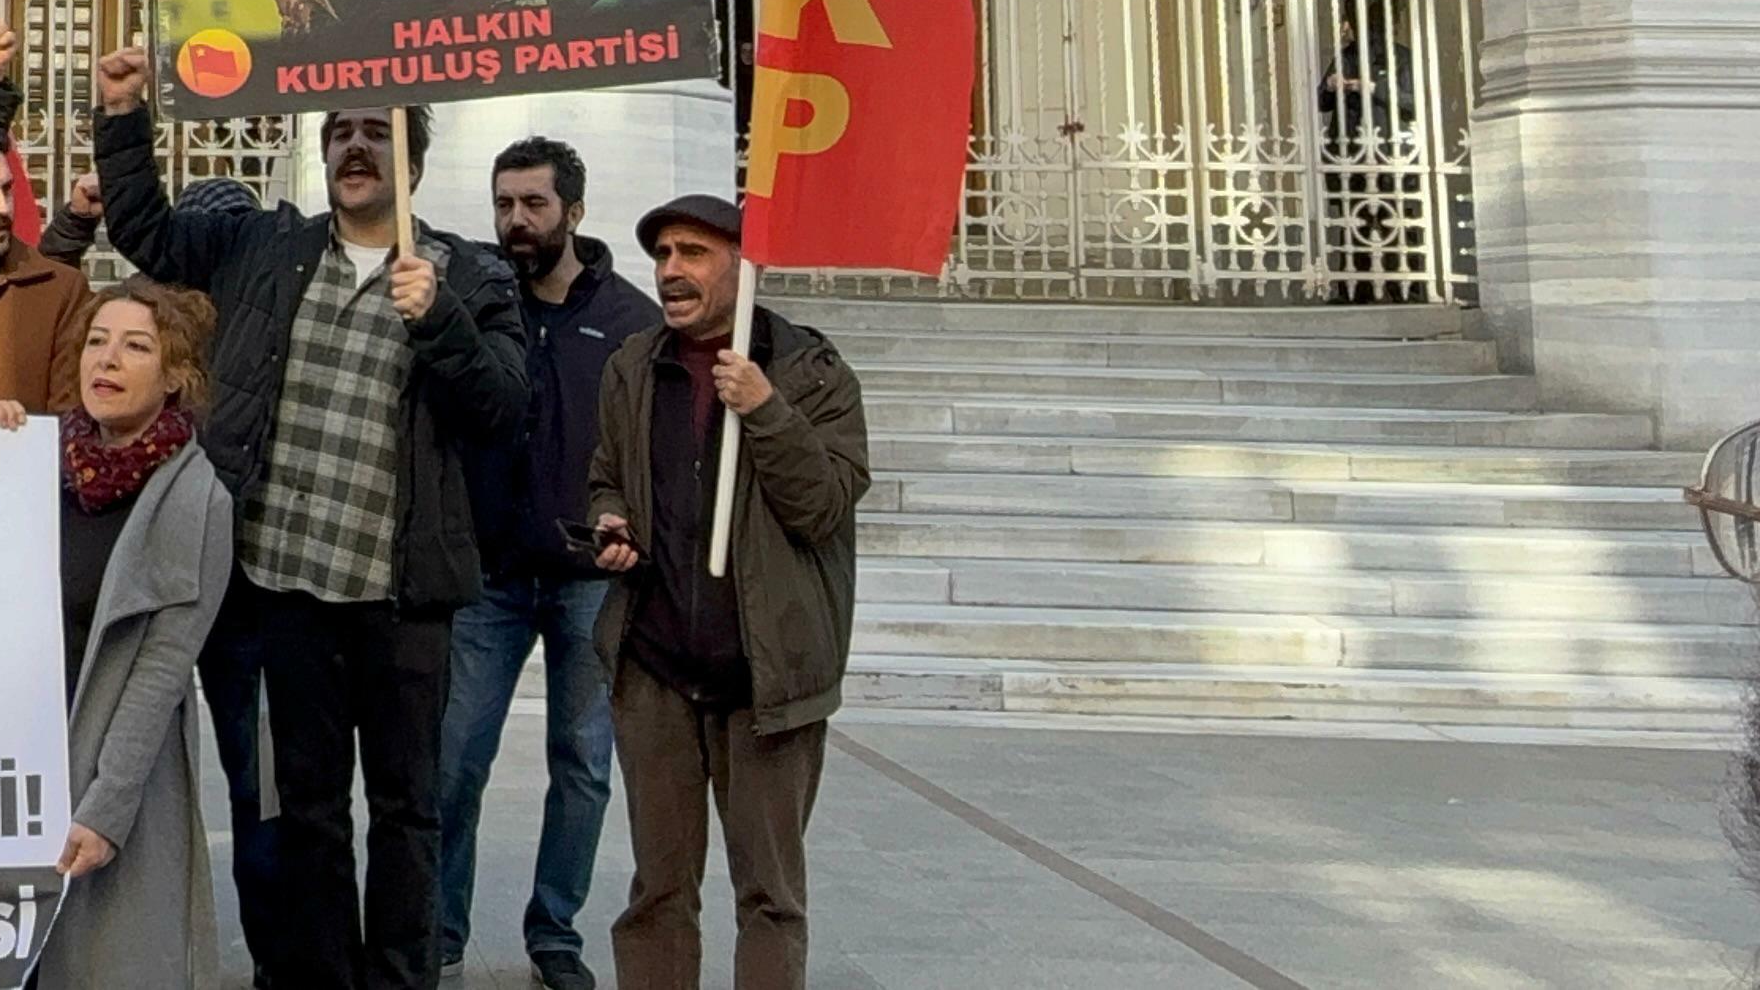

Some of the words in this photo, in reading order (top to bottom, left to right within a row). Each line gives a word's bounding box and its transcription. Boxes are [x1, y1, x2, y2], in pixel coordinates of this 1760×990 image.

[393, 8, 553, 50] HALKIN
[275, 50, 503, 93] KURTULUŞ
[513, 23, 681, 73] PARTİSİ
